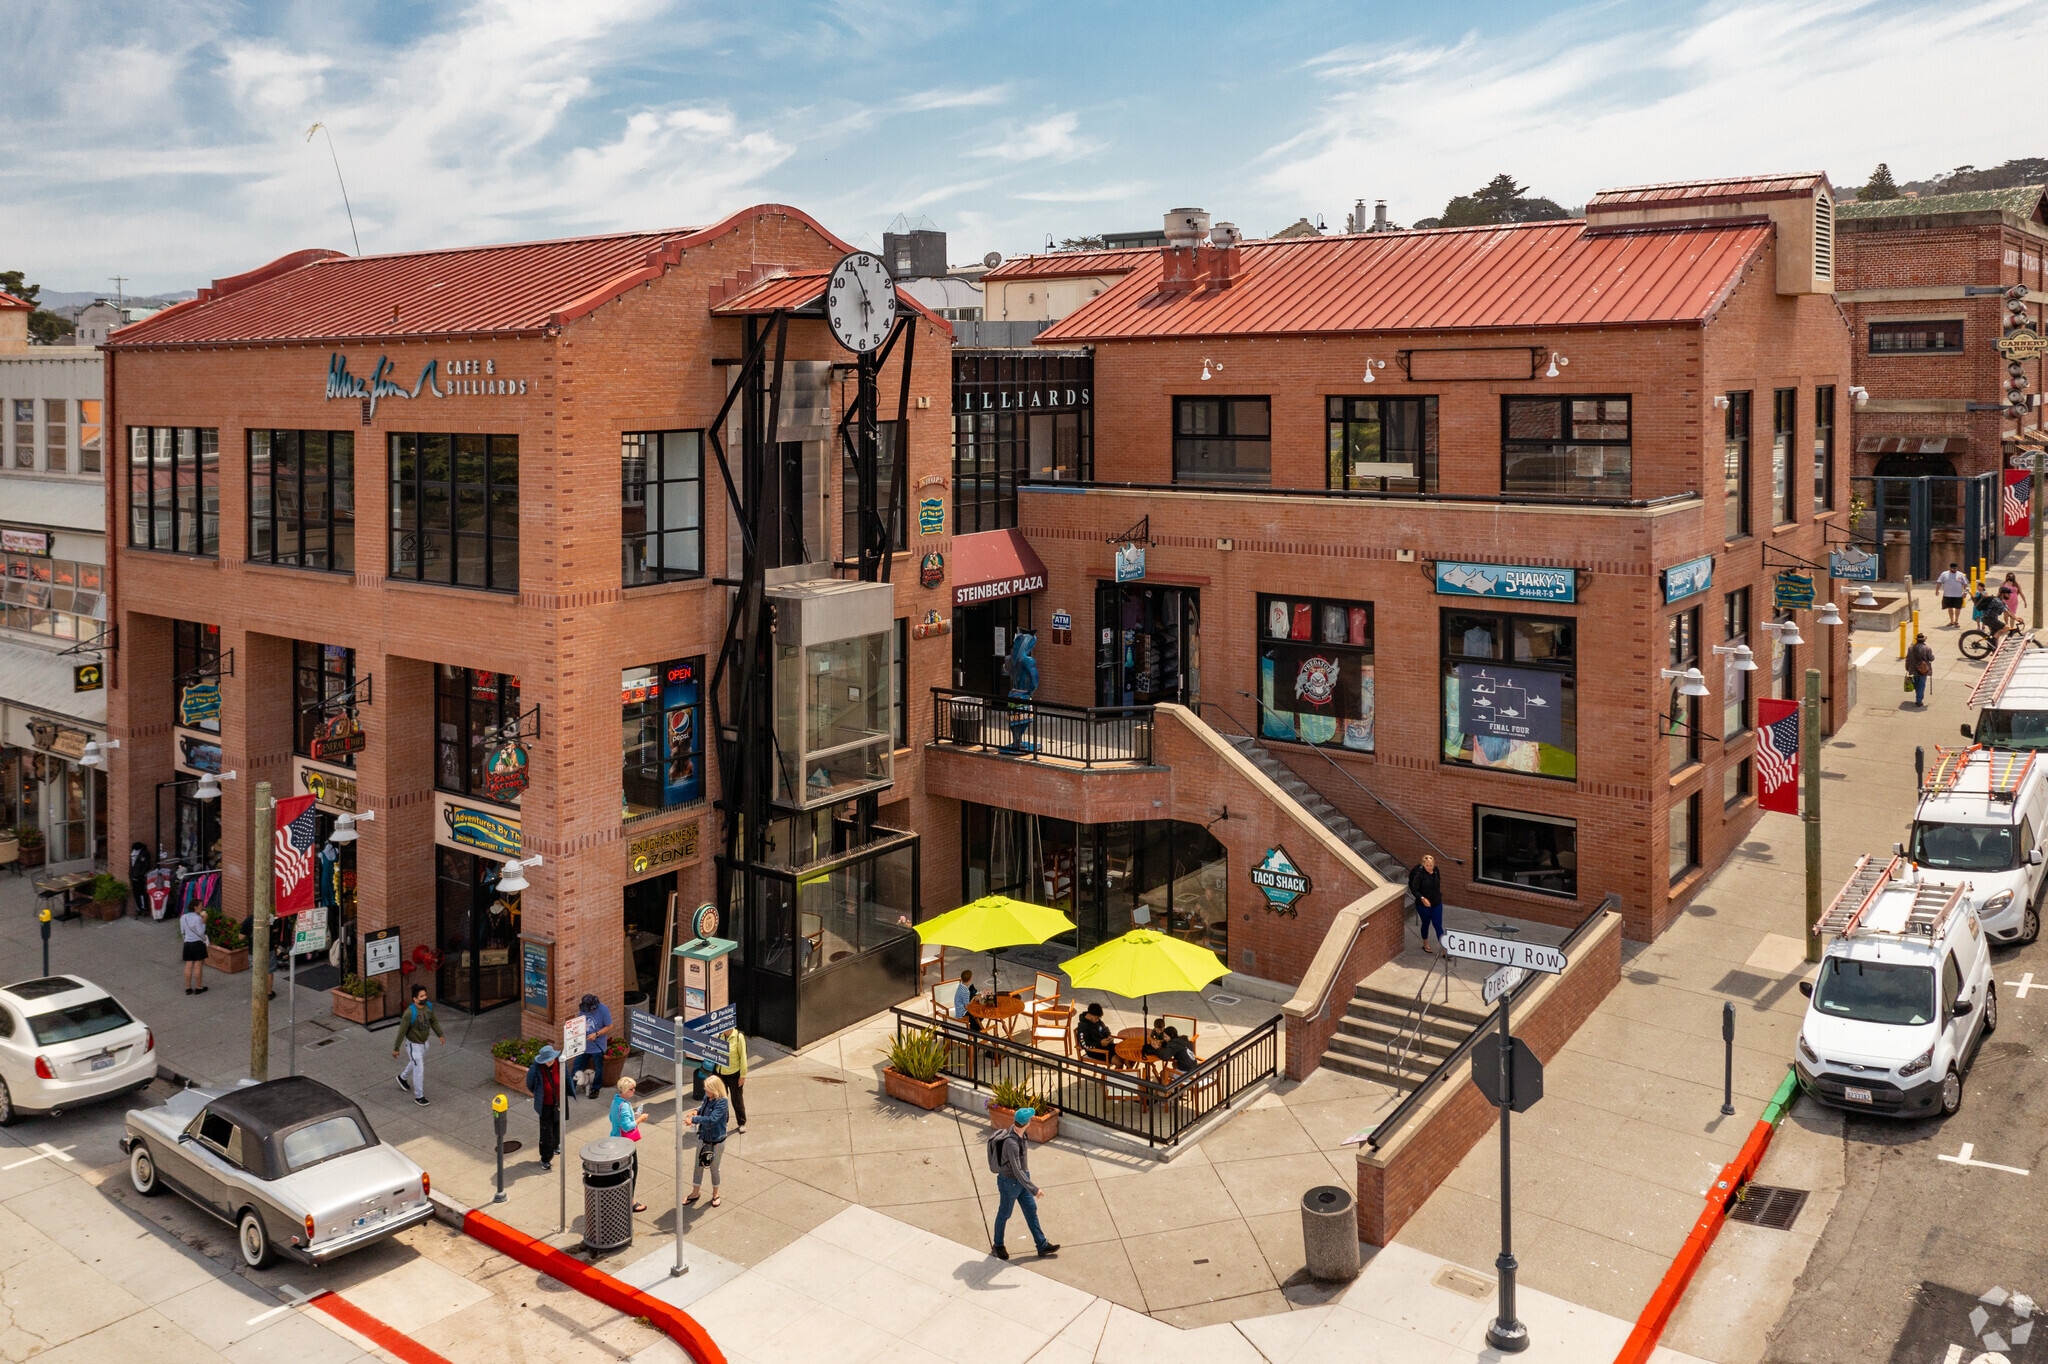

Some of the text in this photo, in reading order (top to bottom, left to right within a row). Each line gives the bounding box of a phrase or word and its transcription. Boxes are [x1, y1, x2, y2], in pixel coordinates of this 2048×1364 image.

[844, 261, 854, 272] 11
[858, 255, 870, 267] 12
[875, 263, 881, 273] 1
[833, 277, 845, 289] 10
[884, 278, 891, 289] 2
[829, 296, 837, 307] 9
[888, 298, 895, 309] 3
[834, 317, 841, 328] 8
[883, 318, 890, 328] 4
[845, 333, 852, 344] 7
[859, 339, 866, 350] 6
[873, 333, 880, 344] 5
[447, 359, 497, 375] CAFE &
[447, 380, 527, 395] BILLIARDS
[951, 388, 1089, 410] ILLIARDS
[921, 477, 944, 485] SHOPS
[1835, 564, 1872, 576] SHARKY'S
[1505, 571, 1566, 594] SHARKY'S
[957, 575, 1044, 603] STEINBECK PLAZA
[1055, 616, 1069, 625] ATM
[1303, 658, 1333, 676] PREDATOR
[668, 667, 692, 681] OPEN
[1489, 722, 1530, 735] FINAL FOUR
[672, 732, 689, 743] pepsi
[494, 773, 520, 783] CANDY
[490, 779, 523, 791] FACTORY
[455, 812, 521, 841] Adventures By Th
[650, 843, 695, 866] ZONE
[1252, 870, 1306, 893] TACO SHACK
[1448, 934, 1559, 969] Cannery Row
[632, 1010, 656, 1024] Cannery Row
[718, 1006, 734, 1017] Parking
[633, 1024, 652, 1036] Downtown
[718, 1019, 735, 1030] District
[632, 1037, 665, 1054] Fisherman's Wharf
[708, 1038, 729, 1050] Aquarium
[701, 1049, 728, 1063] Cannery Row
